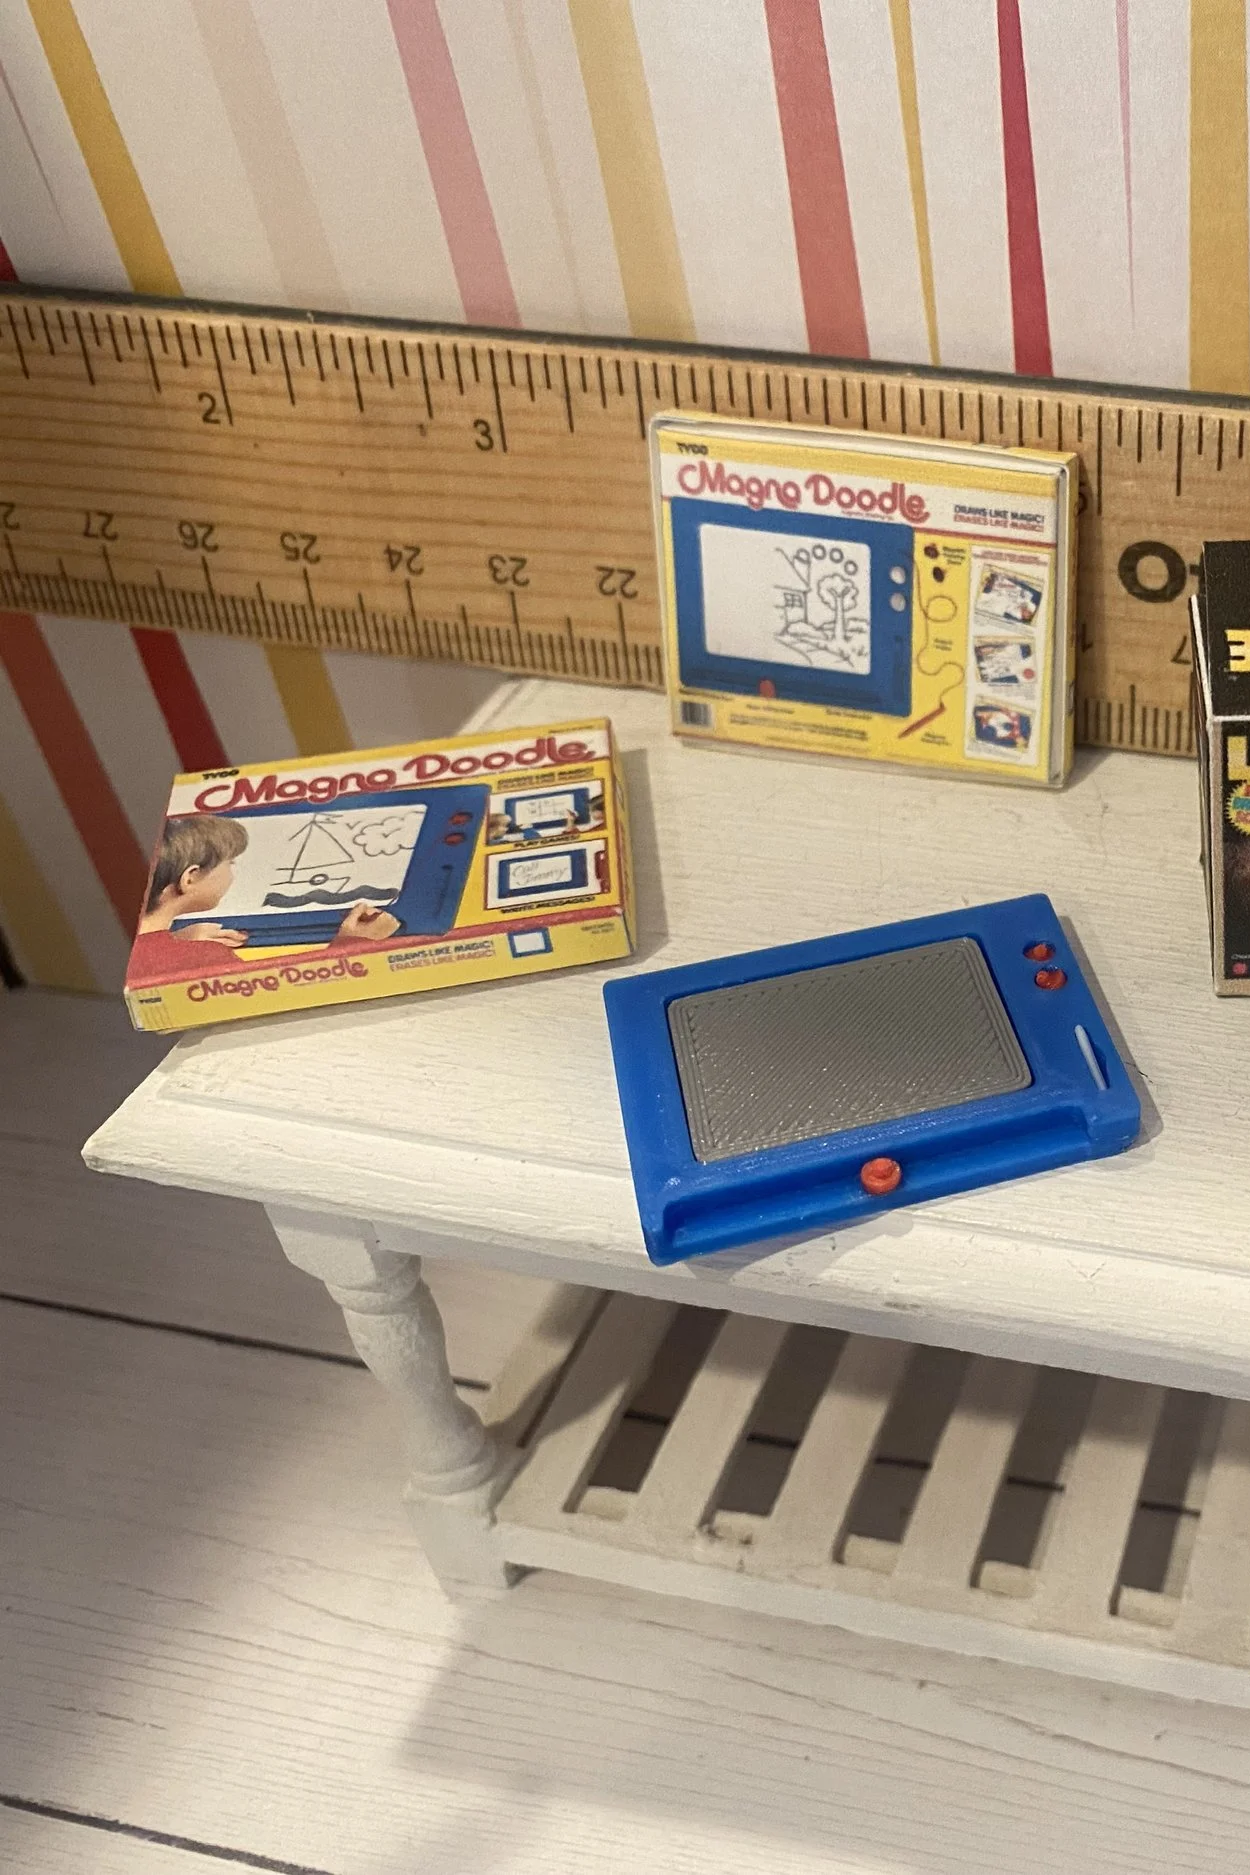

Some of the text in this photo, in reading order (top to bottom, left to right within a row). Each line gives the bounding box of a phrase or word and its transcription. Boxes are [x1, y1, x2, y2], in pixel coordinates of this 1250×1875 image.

[199, 392, 221, 424] 2
[474, 419, 494, 450] 3
[677, 460, 930, 524] Magna Doodle
[194, 769, 397, 813] Magna
[402, 736, 596, 783] Doodle
[187, 974, 280, 1003] Magna
[280, 959, 368, 984] Doodle
